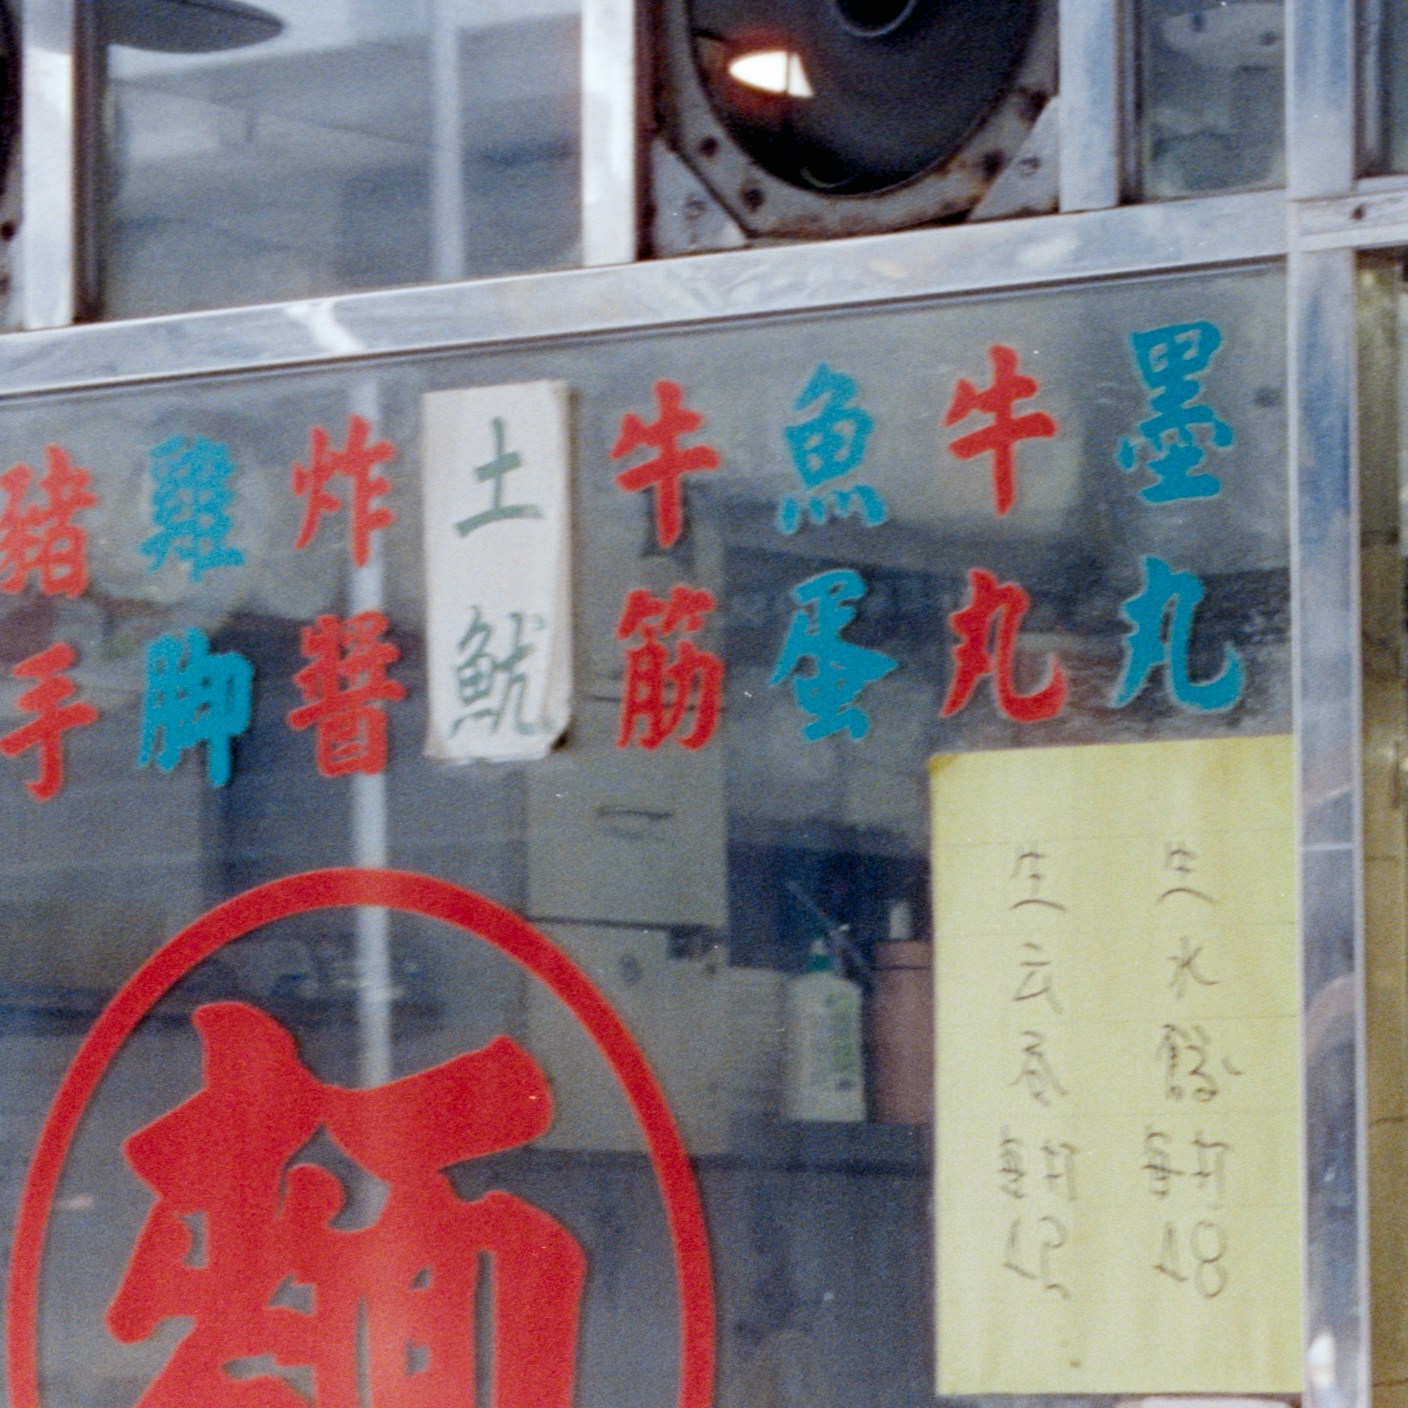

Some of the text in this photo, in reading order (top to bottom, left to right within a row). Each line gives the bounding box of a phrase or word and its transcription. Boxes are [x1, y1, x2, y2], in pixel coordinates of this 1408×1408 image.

[285, 413, 407, 778] 炸醬
[452, 416, 548, 738] 土魷
[609, 378, 725, 752] 牛筋
[767, 360, 899, 744] 魚蛋
[939, 342, 1068, 724] 牛丸
[1107, 319, 1246, 714] 墨丸
